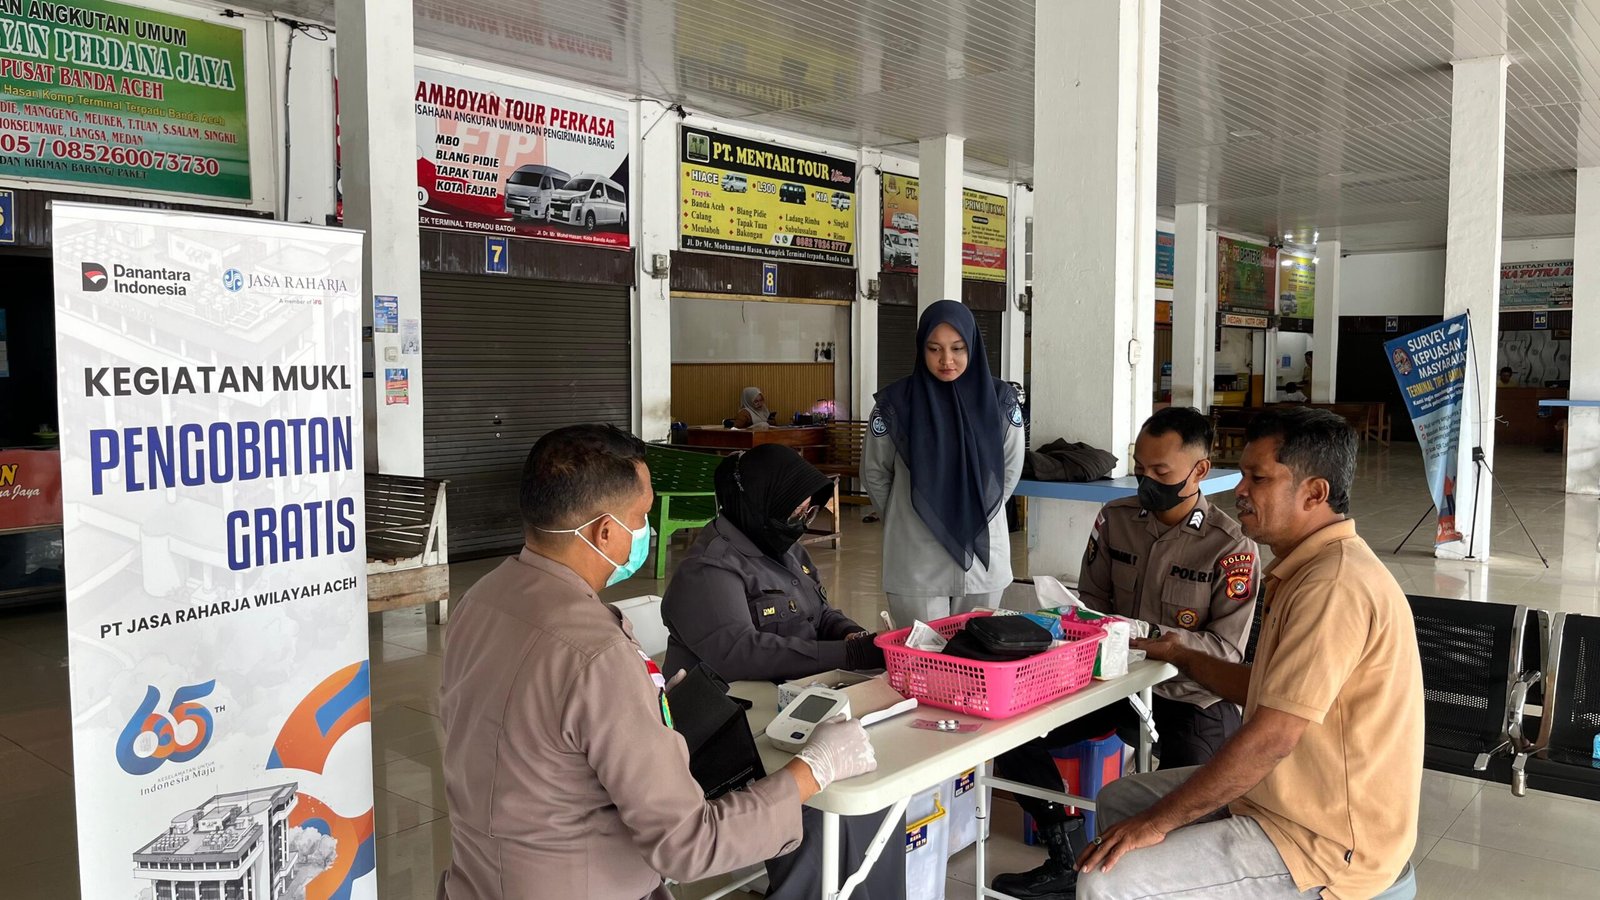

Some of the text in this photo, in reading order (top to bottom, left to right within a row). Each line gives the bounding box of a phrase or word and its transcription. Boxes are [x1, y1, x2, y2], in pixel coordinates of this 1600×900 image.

[28, 1, 129, 35] ANGKUTAN
[136, 22, 187, 47] UMUM
[55, 29, 174, 79] PERDANA
[177, 51, 236, 90] JAYA
[1, 58, 164, 100] PUSAT BANDA ACEH
[4, 84, 226, 126] Hasan Komp Terminal Terpadu Banda Aceh
[415, 81, 615, 138] AMBOYAN TOUR PERKASA
[24, 104, 81, 123] MANGGENG,
[85, 113, 125, 129] MEUKEK,
[128, 119, 160, 134] T.TUAN,
[204, 130, 238, 144] SINGKIL
[454, 113, 498, 129] ANGKUTAN
[499, 119, 524, 134] UMUM
[525, 124, 543, 138] DAN
[543, 128, 587, 146] PENGIRIMAN
[588, 137, 615, 150] BARANG
[70, 126, 109, 143] LANGSA,
[112, 132, 144, 146] MEDAN
[435, 134, 460, 147] MBO
[1, 134, 31, 153] 05
[53, 140, 219, 176] 085260073730
[436, 150, 499, 168] BLANG PIDIE
[713, 141, 734, 163] PT.
[736, 146, 795, 174] MENTARI
[797, 160, 830, 181] TOUR
[0, 155, 20, 166] DAN
[24, 158, 68, 171] KIRIMAN
[117, 170, 147, 180] PAKET
[436, 165, 498, 182] TAPAK TUAN
[691, 169, 719, 185] HIACE
[437, 180, 497, 197] KOTA FAJAR
[815, 191, 829, 204] KIA
[691, 199, 725, 211] Banda Aceh
[736, 207, 767, 218] Blang Pidie
[431, 217, 463, 228] TERMINAL
[465, 221, 494, 231] TERPADU
[495, 225, 516, 233] BATOH
[691, 211, 712, 223] Calang
[736, 219, 768, 230] Tapak Tuan
[785, 214, 804, 225] Ladang
[692, 223, 720, 235] Meulaboh
[736, 229, 763, 240] Bakongan
[491, 245, 503, 263] 7
[786, 250, 806, 259] Terminal
[113, 263, 191, 282] Danantara
[766, 272, 774, 286] 8
[114, 281, 187, 296] Indonesia
[248, 274, 347, 293] JASA RAHARJA
[1407, 327, 1446, 352] SURVEY
[1412, 338, 1462, 366] KEPUASAN
[84, 366, 264, 397] KEGIATAN
[272, 365, 351, 391] MUKL
[1406, 379, 1435, 398] TERMINAL
[90, 415, 353, 495] PENGOBATAN
[11, 484, 40, 500] Jaya
[226, 497, 355, 571] GRATIS
[1222, 554, 1252, 567] POLDA
[1170, 565, 1214, 584] POLRI
[100, 576, 357, 639] PT JASA RAHARJA WILAYAH ACEH
[116, 679, 226, 776] 65 TH
[140, 767, 216, 796] Indonesia Maju
